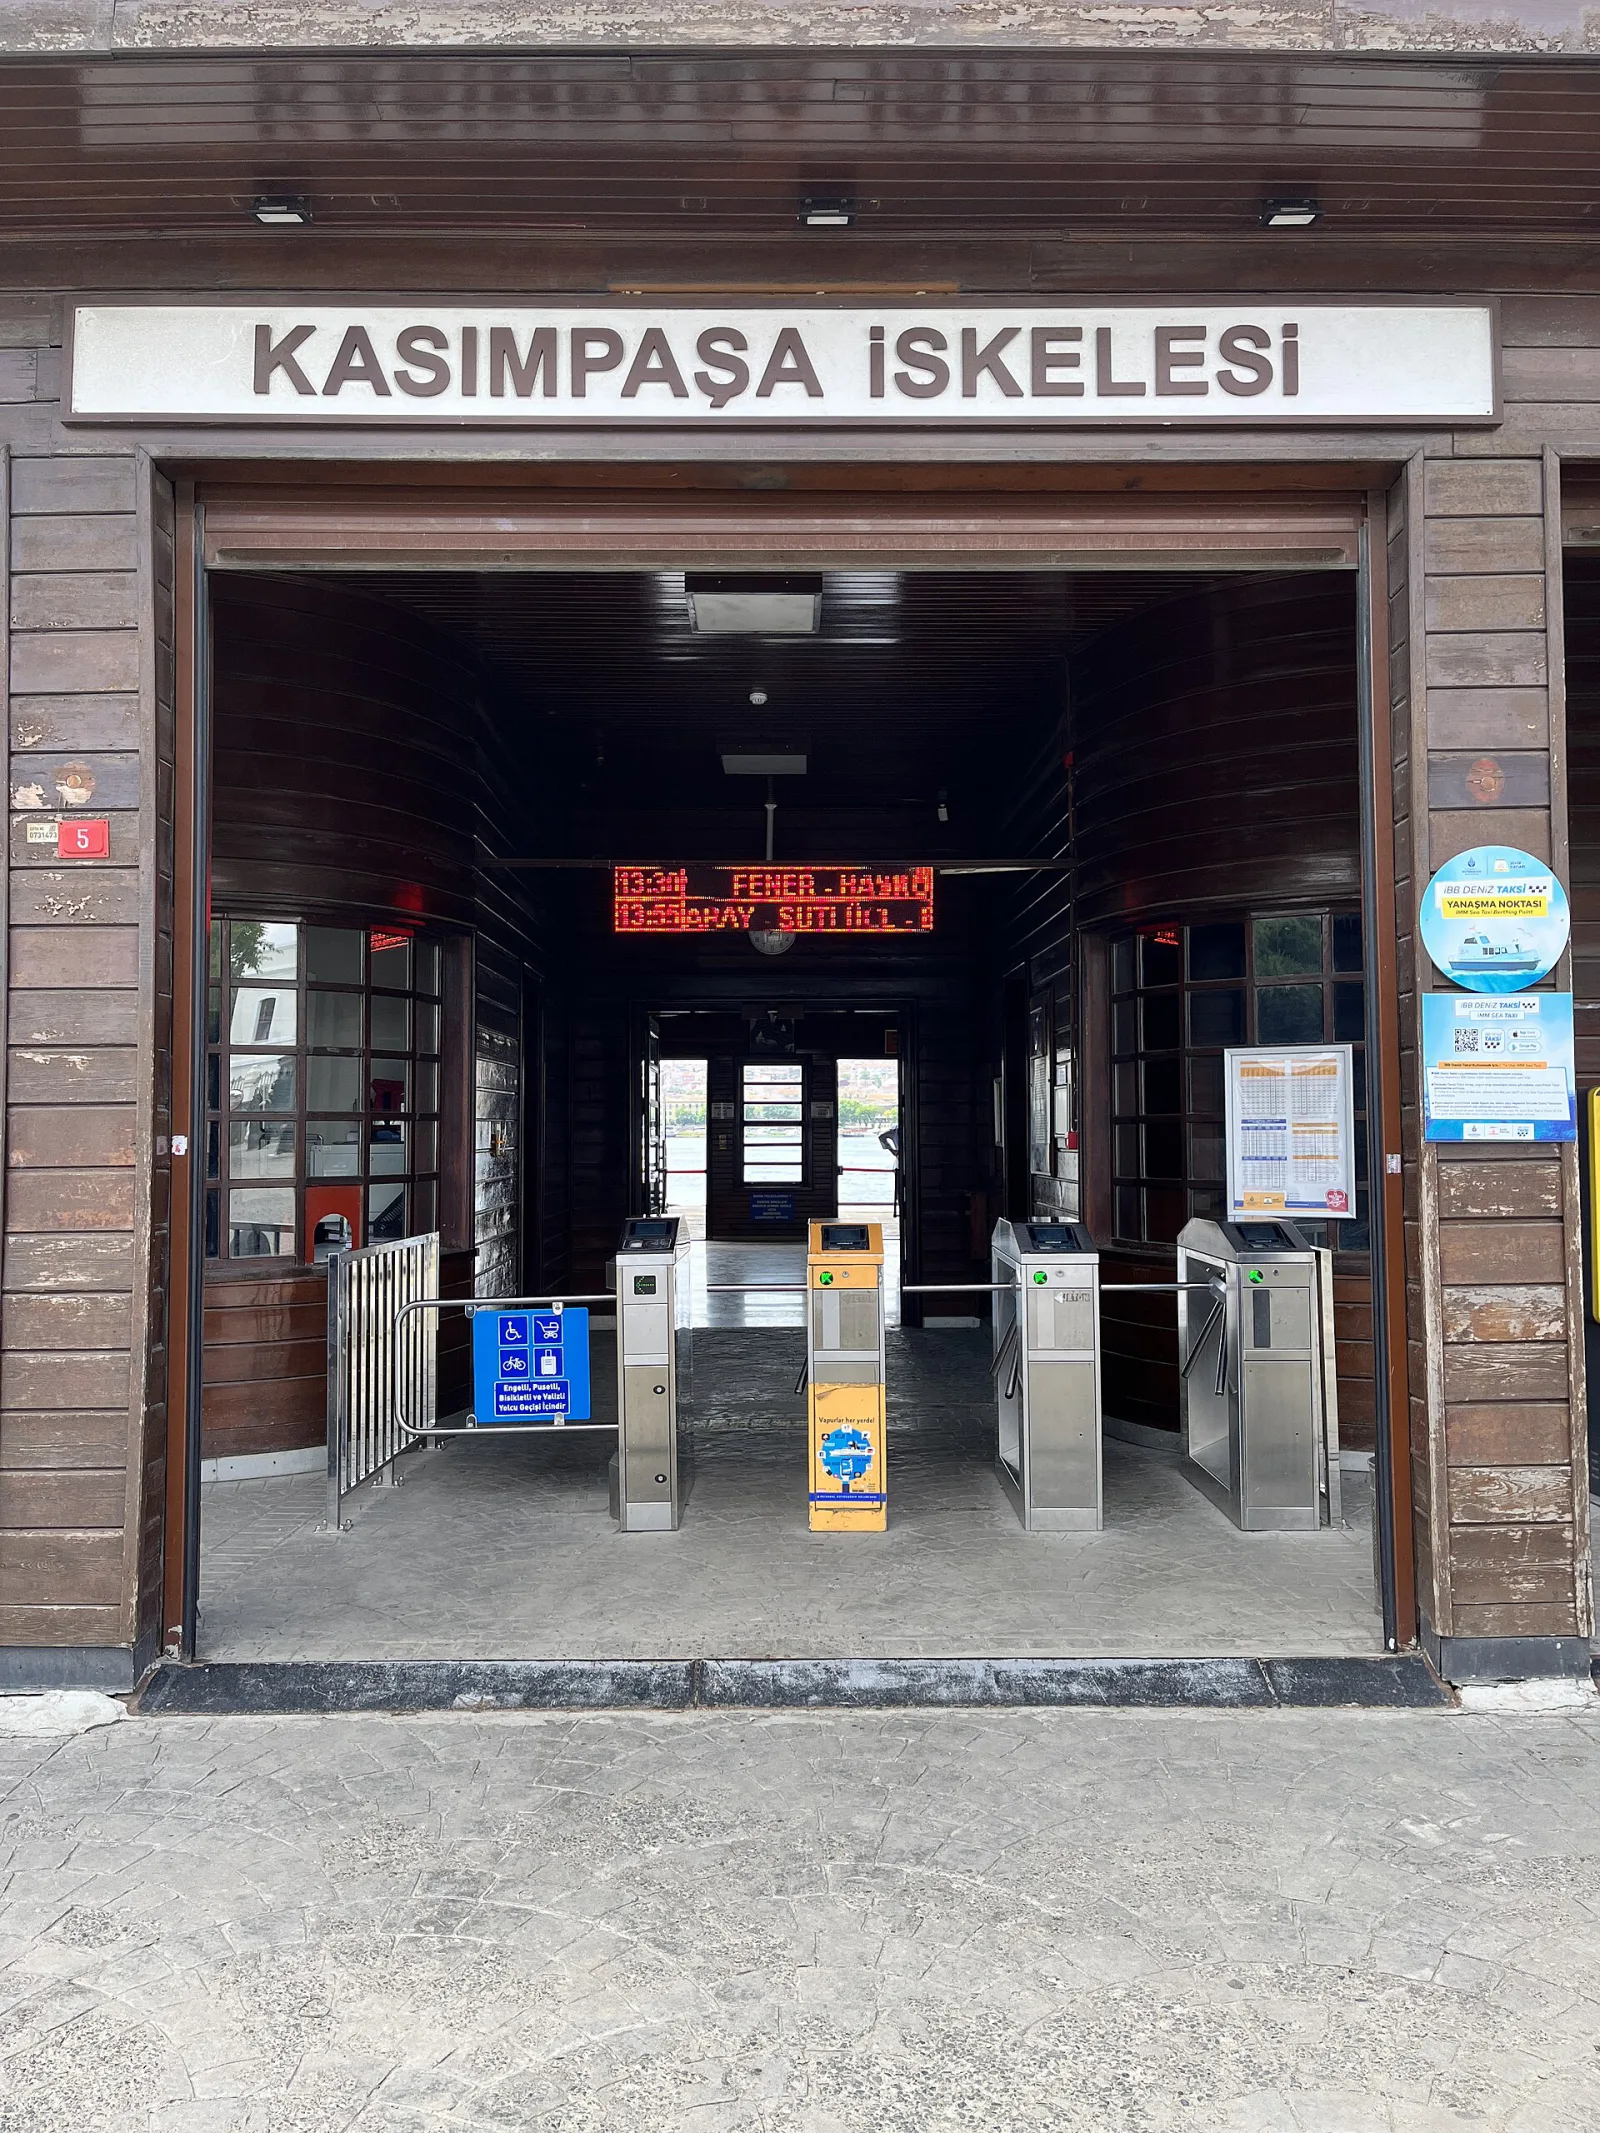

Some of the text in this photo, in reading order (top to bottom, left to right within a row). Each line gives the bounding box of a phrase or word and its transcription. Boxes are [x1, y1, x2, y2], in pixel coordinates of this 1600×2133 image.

[253, 325, 824, 408] KASIMPAŞA
[77, 828, 89, 849] 5
[733, 874, 816, 896] FENER
[1497, 883, 1526, 893] TAKSİ
[1447, 900, 1542, 909] YANAŞMA NOKTASI
[1499, 1001, 1520, 1009] TAKSİ
[503, 1383, 560, 1393] Engelli, Pusetli,
[499, 1394, 532, 1402] Bisikletli
[543, 1392, 566, 1400] Valizli
[498, 1402, 566, 1412] Yolcu Geçişi İçindir
[856, 1417, 875, 1425] yerde!
